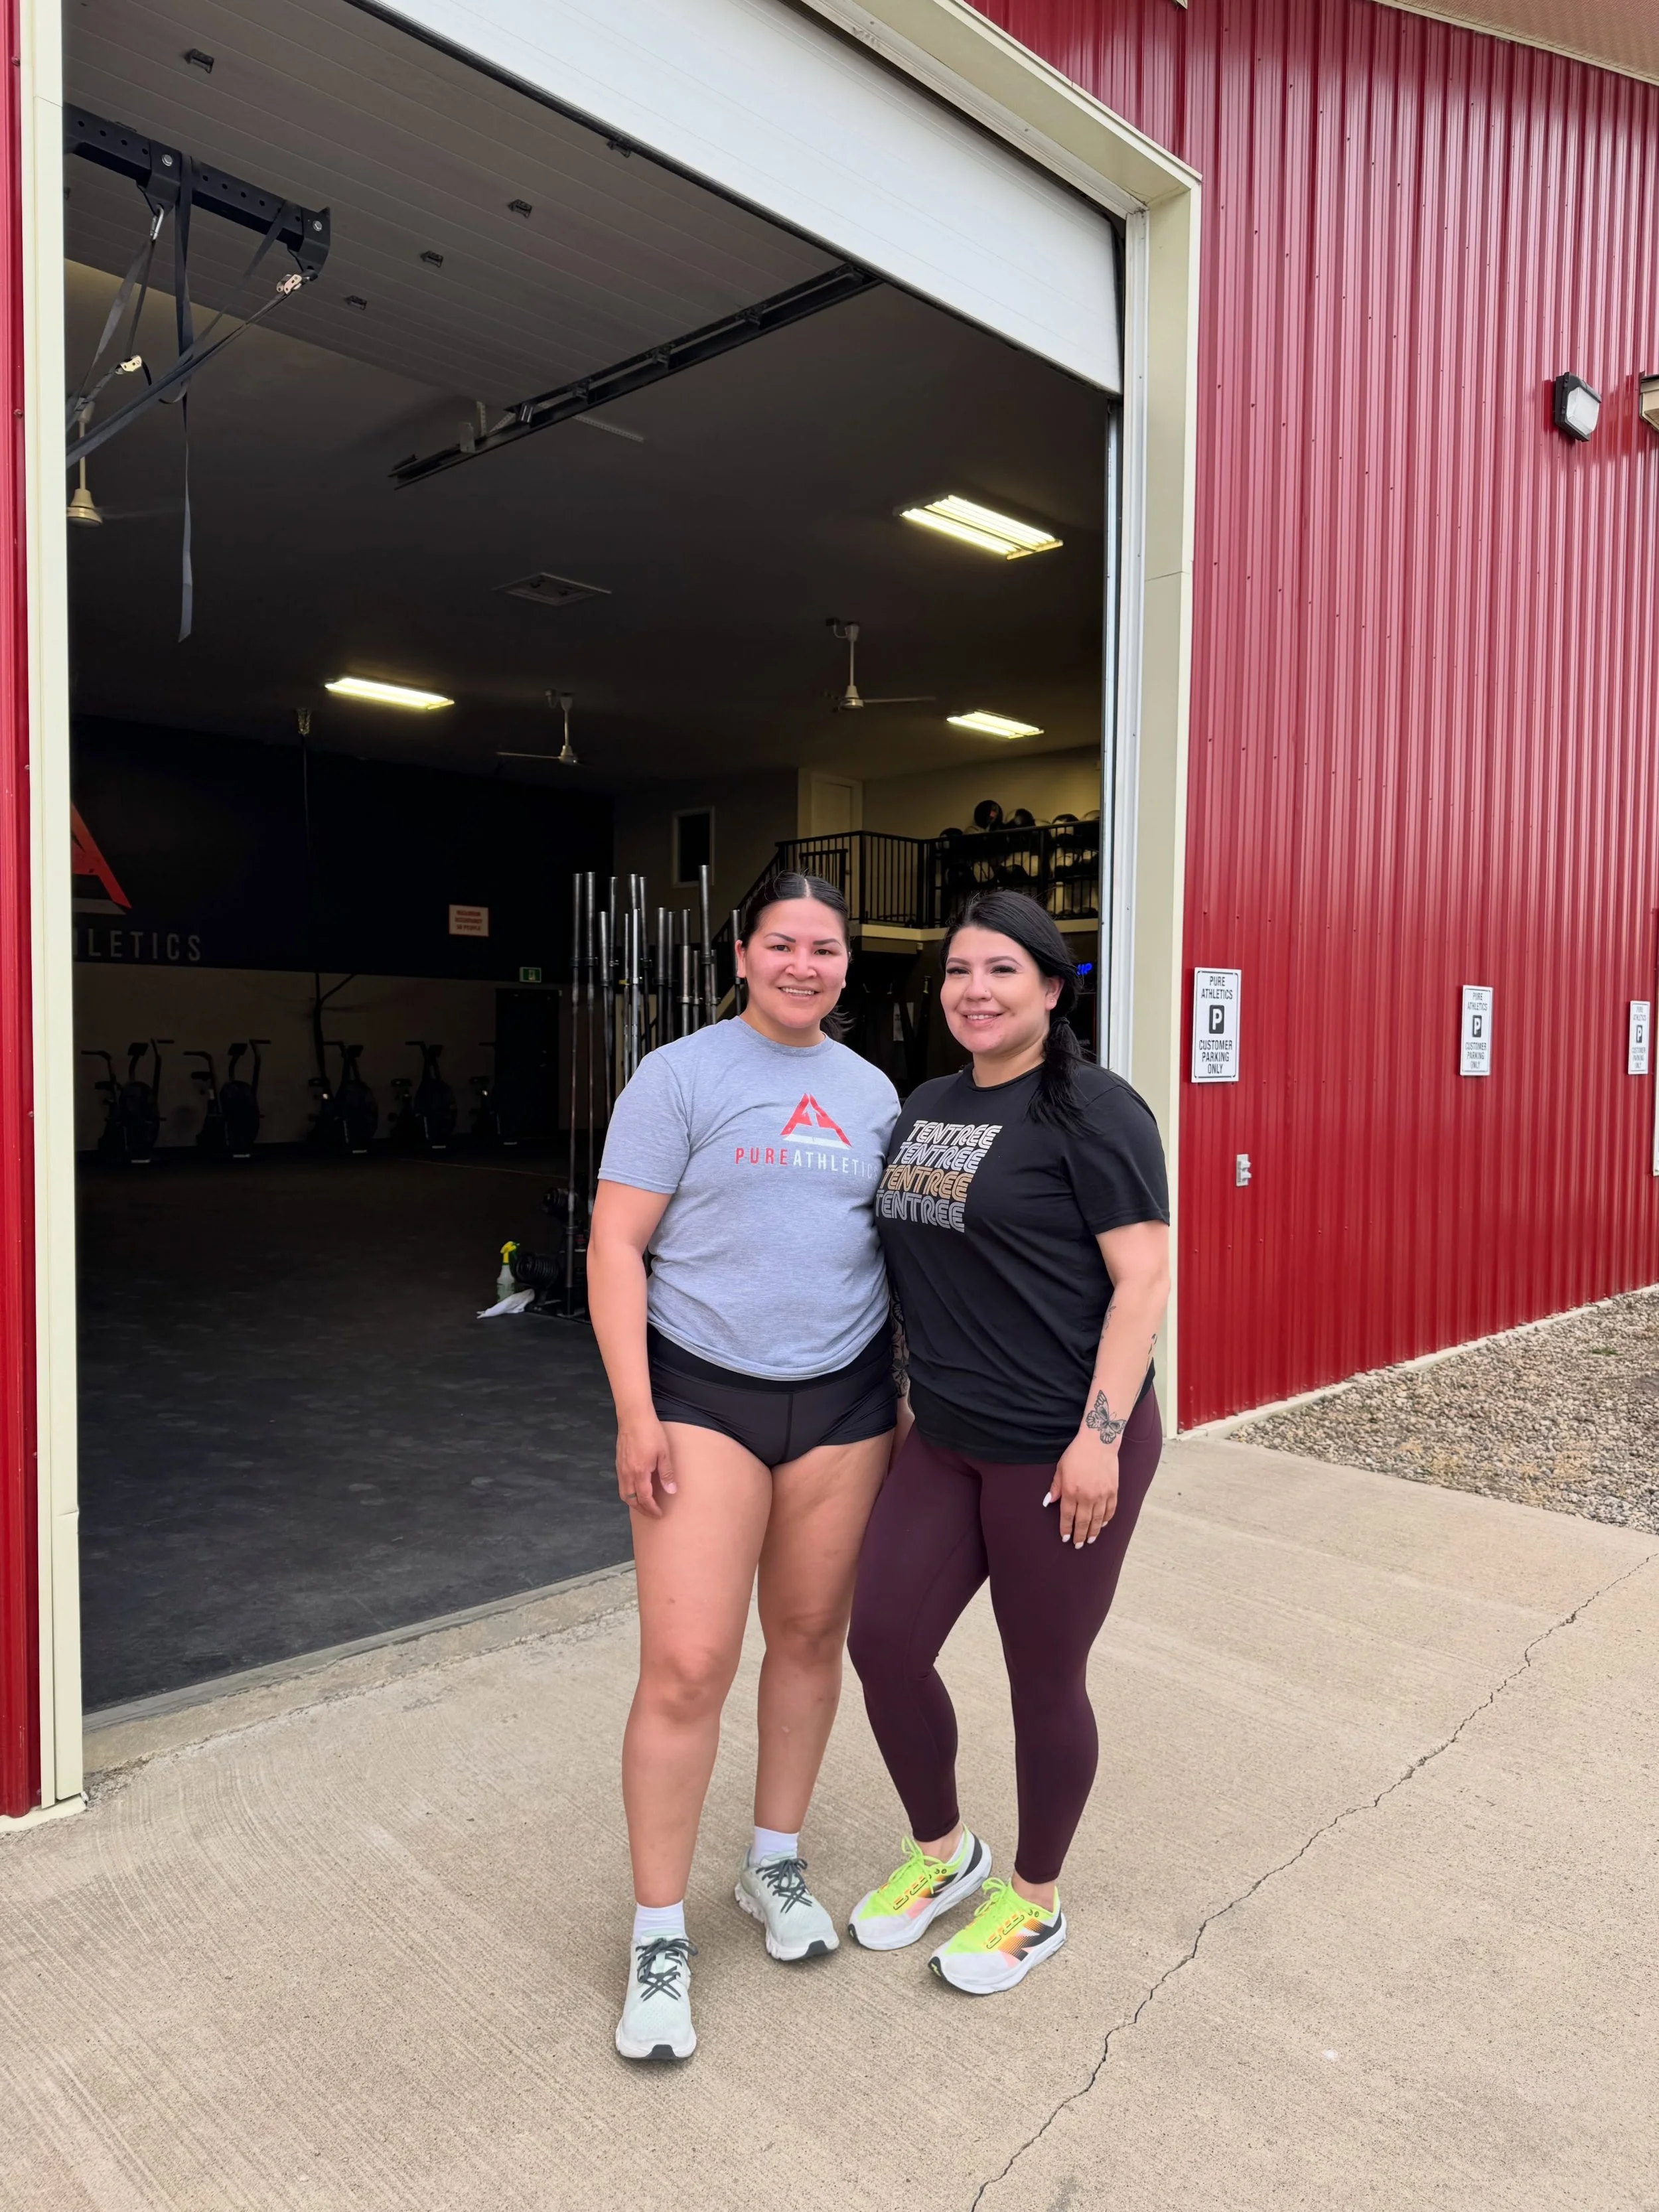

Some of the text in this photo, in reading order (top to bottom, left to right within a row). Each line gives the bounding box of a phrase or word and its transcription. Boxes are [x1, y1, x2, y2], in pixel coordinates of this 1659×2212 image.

[1209, 976, 1226, 987] PURE
[1201, 988, 1233, 1000] ATHLETICS
[1467, 1001, 1488, 1011] ATHLETICS
[1212, 1008, 1223, 1031] P
[1474, 1017, 1481, 1035] P
[1199, 1039, 1233, 1051] CUSTOMER
[1465, 1042, 1487, 1051] CUSTOMER
[1202, 1051, 1230, 1063] PARKING
[1467, 1051, 1484, 1060] PARKING
[1208, 1063, 1224, 1074] ONLY
[906, 1120, 1003, 1149] TENTREE
[893, 1141, 989, 1174] TENTREE
[879, 1164, 974, 1203] TENTREE
[875, 1189, 966, 1233] TENTREE
